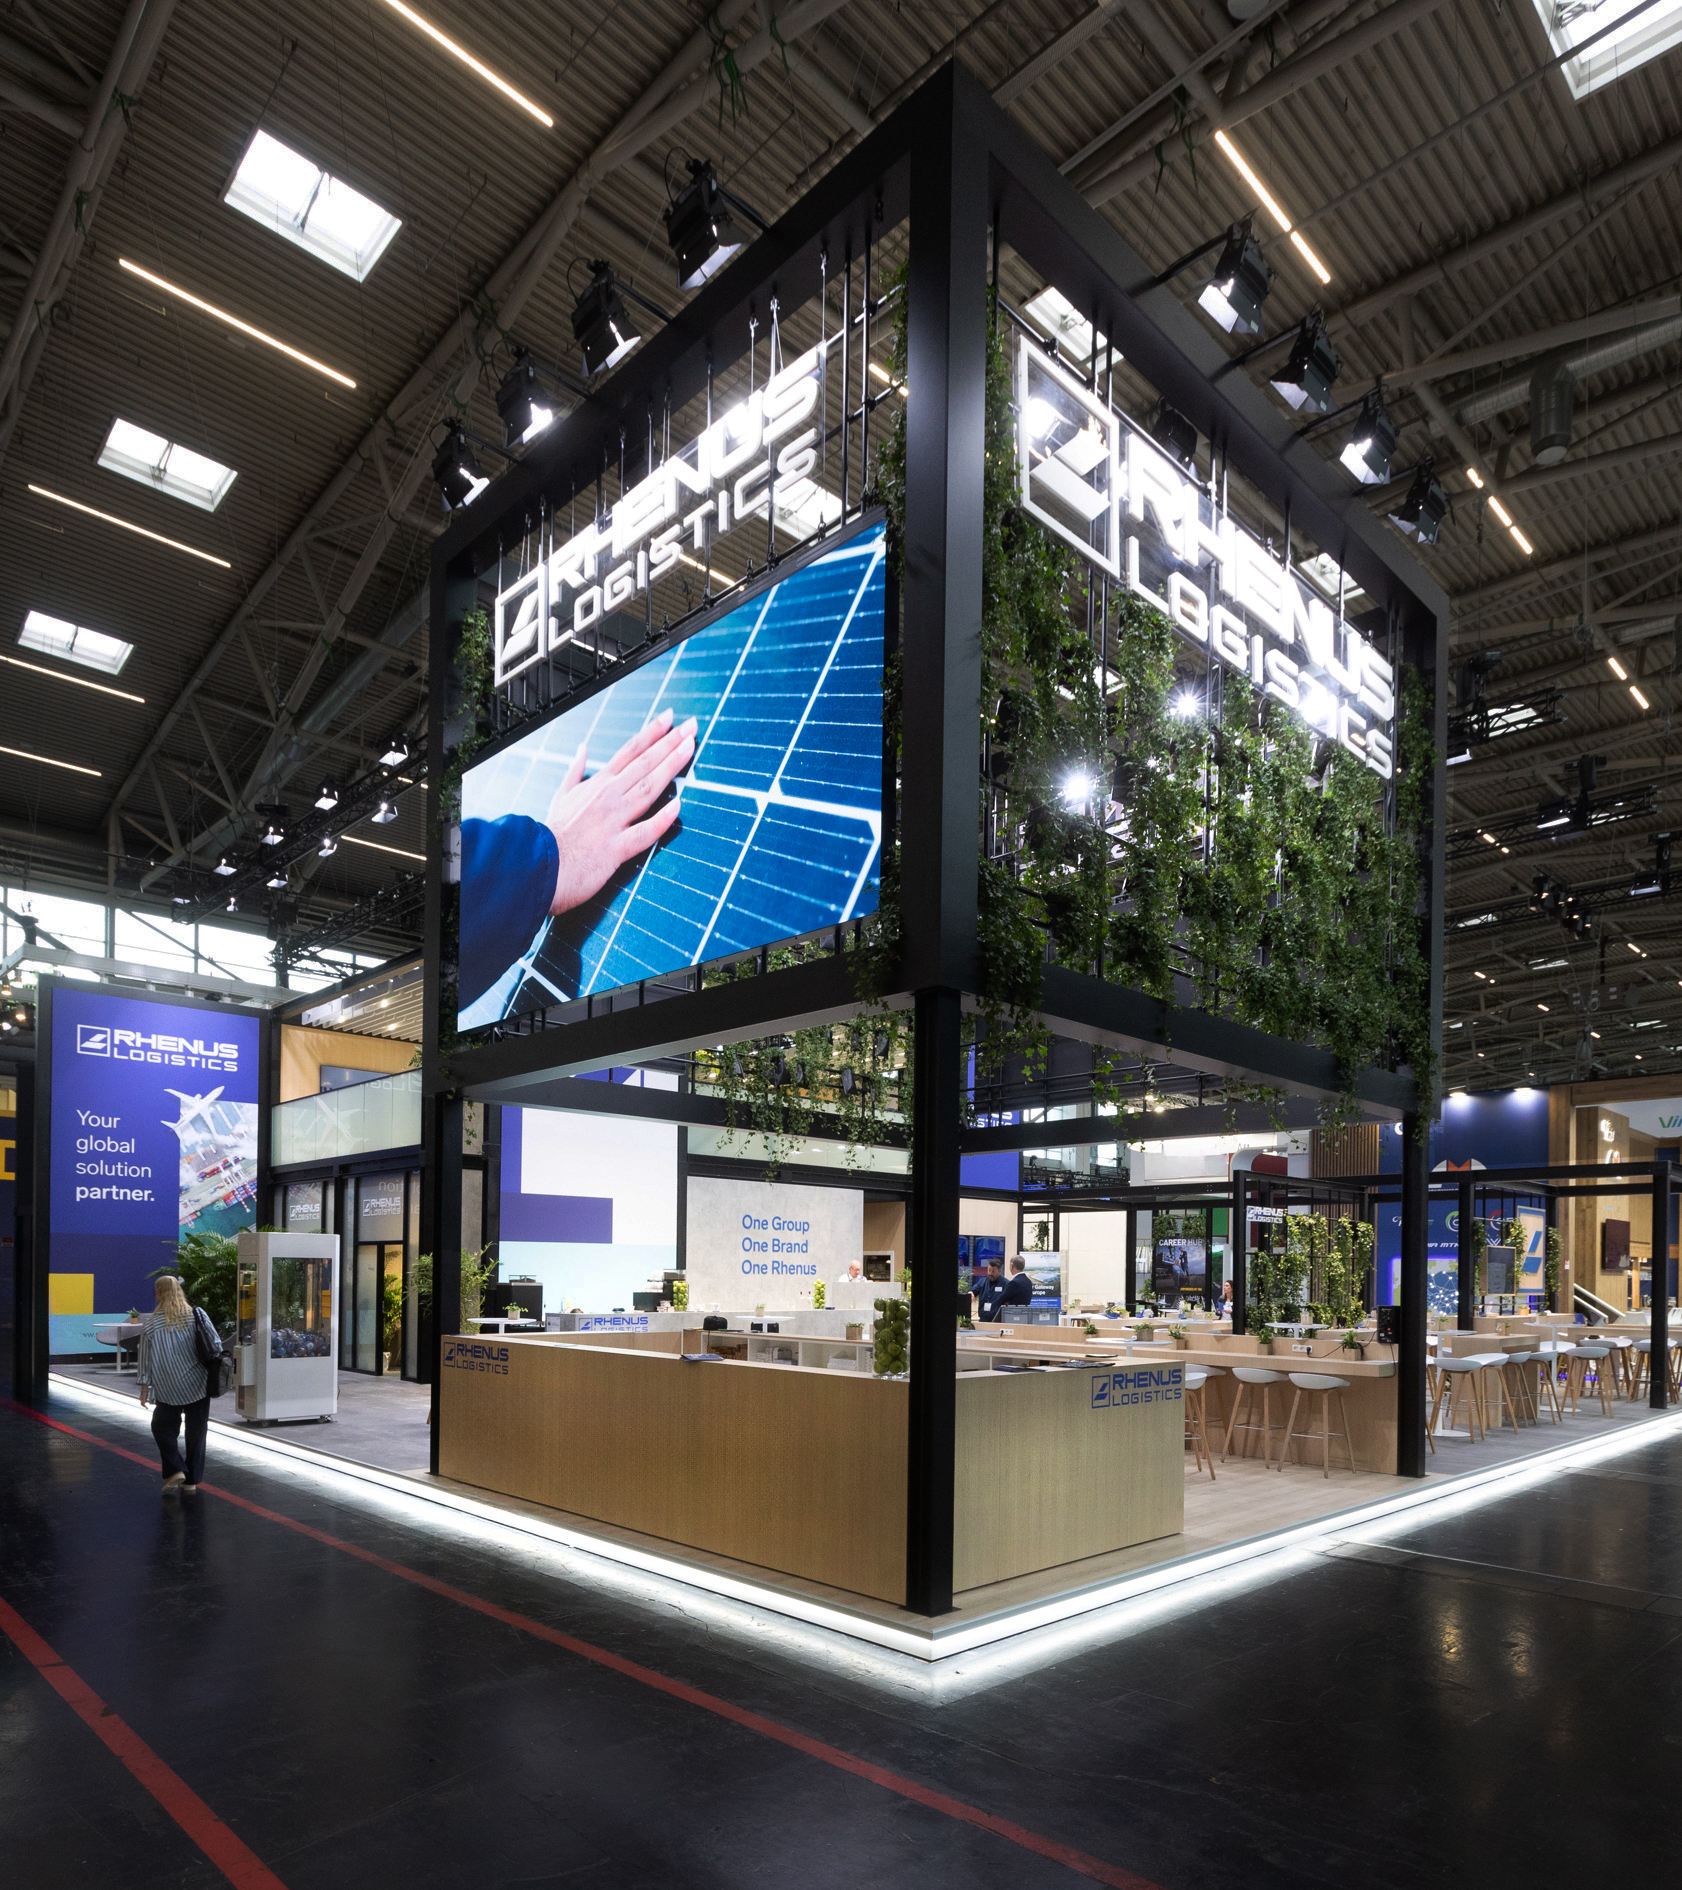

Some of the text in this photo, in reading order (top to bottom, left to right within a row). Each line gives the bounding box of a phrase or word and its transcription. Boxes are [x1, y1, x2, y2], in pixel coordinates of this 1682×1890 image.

[549, 345, 822, 606] RHENUS
[549, 427, 818, 651] LOGISTICS
[1126, 433, 1394, 721] RHENUS
[1126, 536, 1393, 779] LOGISTICS
[113, 1029, 239, 1059] RHENUS
[113, 1047, 238, 1072] LOGISTICS
[76, 1109, 121, 1129] Your
[76, 1135, 135, 1154] global
[76, 1160, 152, 1178] solution
[76, 1185, 155, 1202] partner.
[370, 1196, 401, 1208] RHENUS
[295, 1203, 320, 1213] RHENUS
[370, 1206, 400, 1216] LOGISTICS
[1254, 1206, 1284, 1217] RHENUS
[741, 1214, 810, 1235] One Group
[1254, 1215, 1283, 1224] LOGISTICS
[741, 1237, 809, 1253] One Brand
[1158, 1238, 1187, 1247] CAREER
[741, 1259, 817, 1275] One Rhenus
[594, 1316, 649, 1326] RHENUS
[456, 1343, 509, 1362] RHENUS
[456, 1359, 509, 1375] LOGISTICS
[1112, 1368, 1183, 1391] RHENUS
[1112, 1388, 1182, 1406] LOGISTICS
